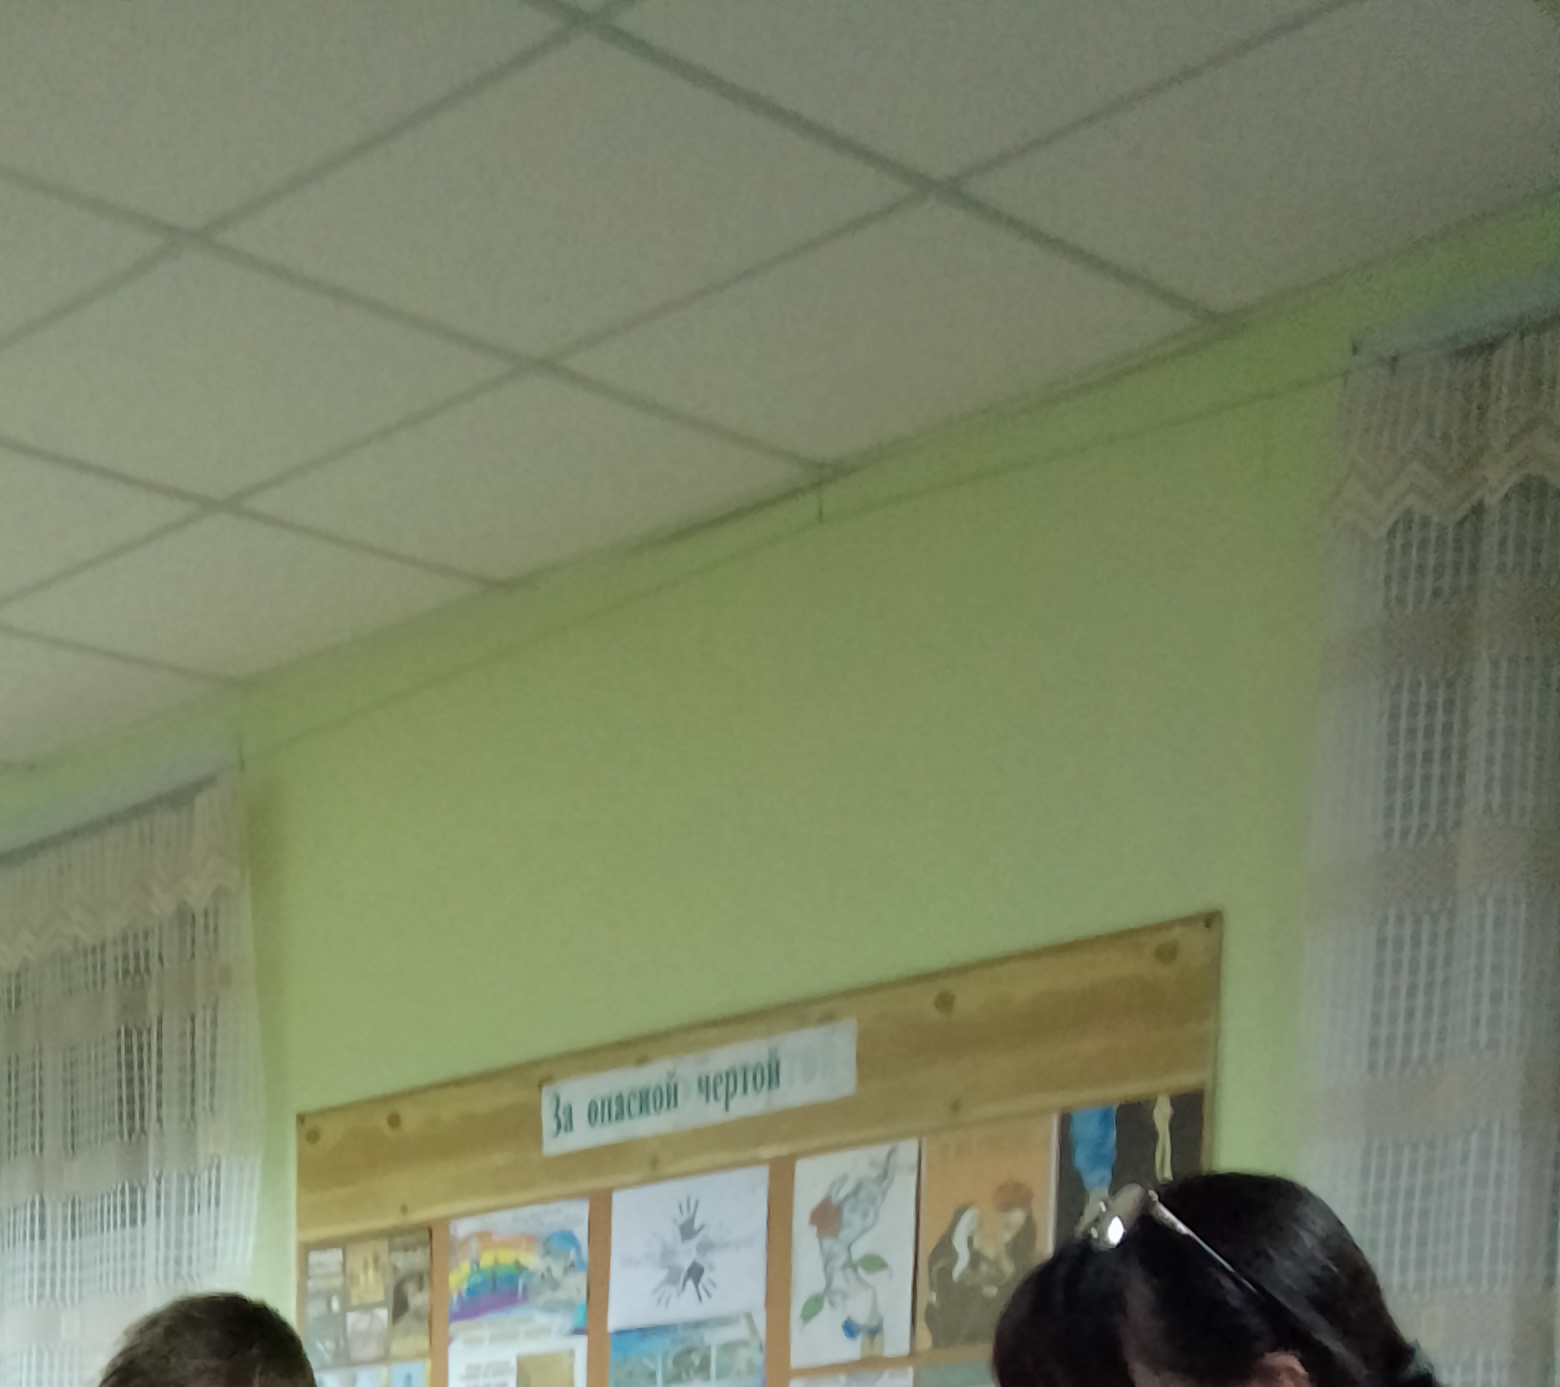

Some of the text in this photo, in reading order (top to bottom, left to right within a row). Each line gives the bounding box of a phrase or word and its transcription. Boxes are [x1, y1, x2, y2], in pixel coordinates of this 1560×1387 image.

[553, 1048, 781, 1138] За опасной чертой
